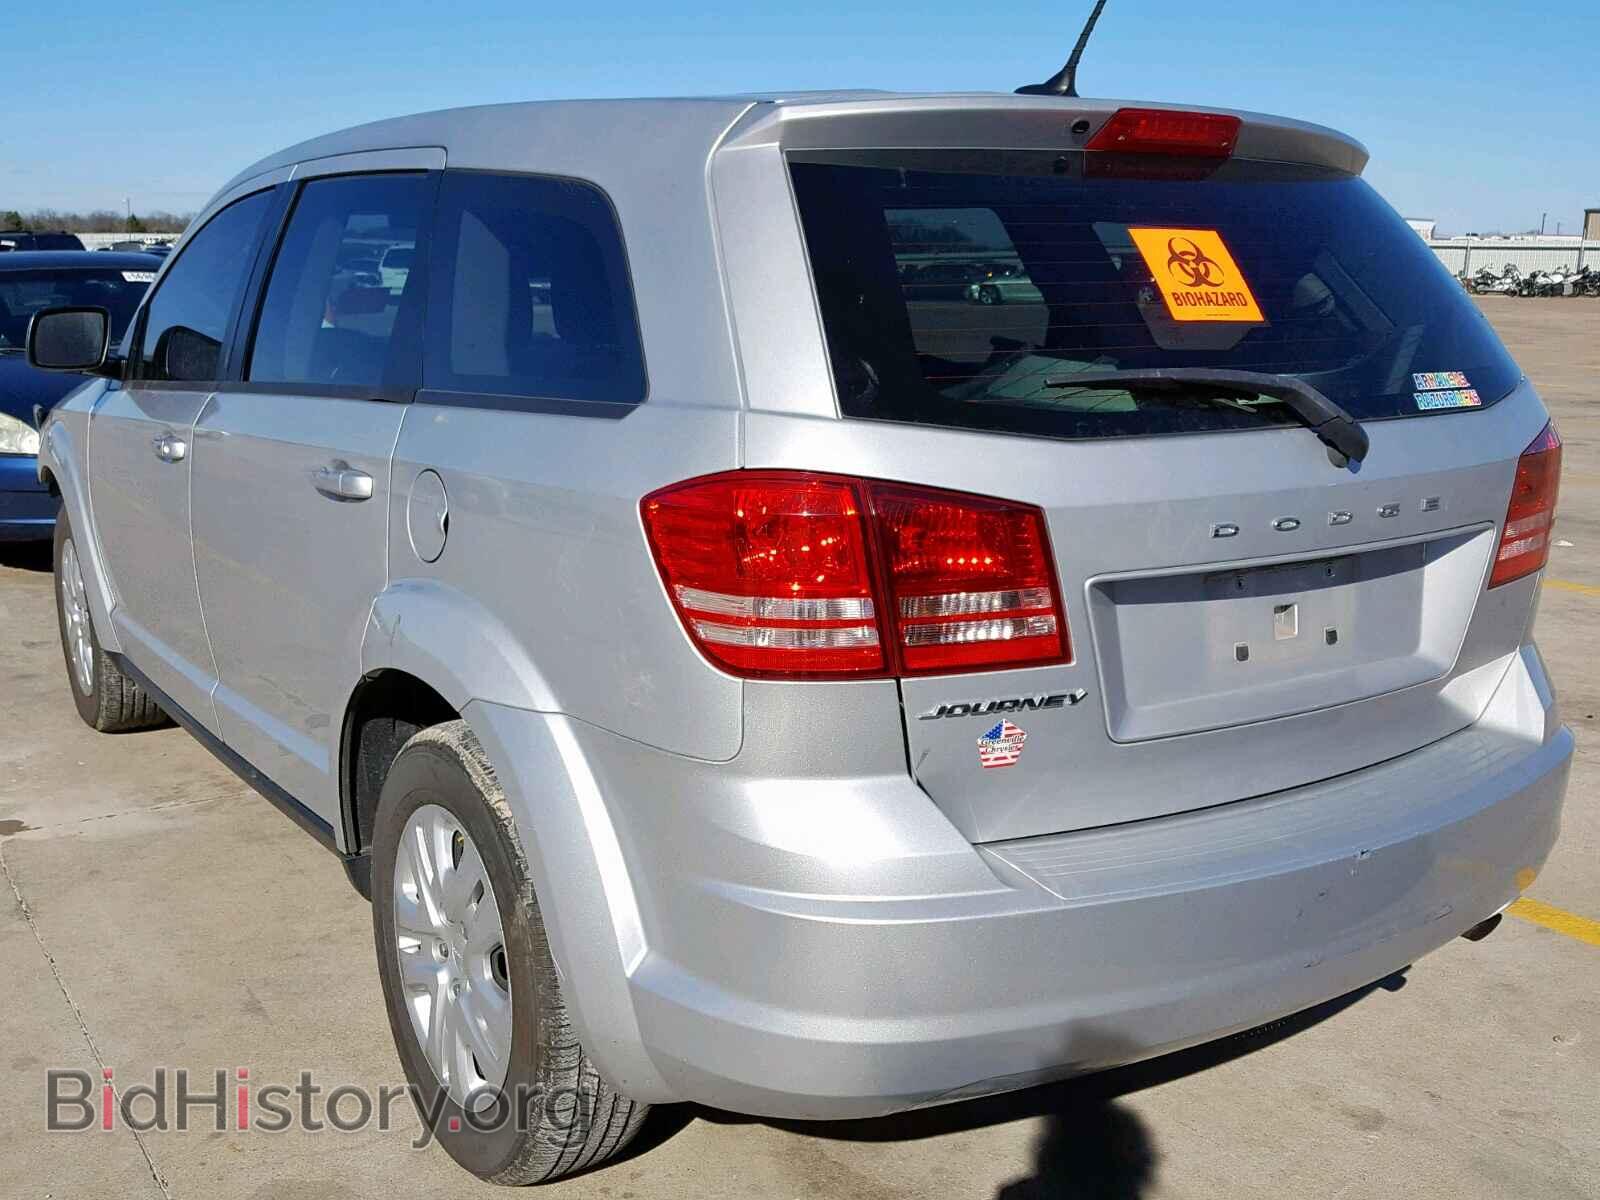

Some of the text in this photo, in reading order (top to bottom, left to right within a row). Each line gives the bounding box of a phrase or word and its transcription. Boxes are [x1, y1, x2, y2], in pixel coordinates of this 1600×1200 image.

[1172, 292, 1248, 307] BIOHAZARD
[1210, 497, 1441, 538] DODGE
[918, 688, 1089, 721] JOURNEY
[980, 735, 1024, 746] Greenville
